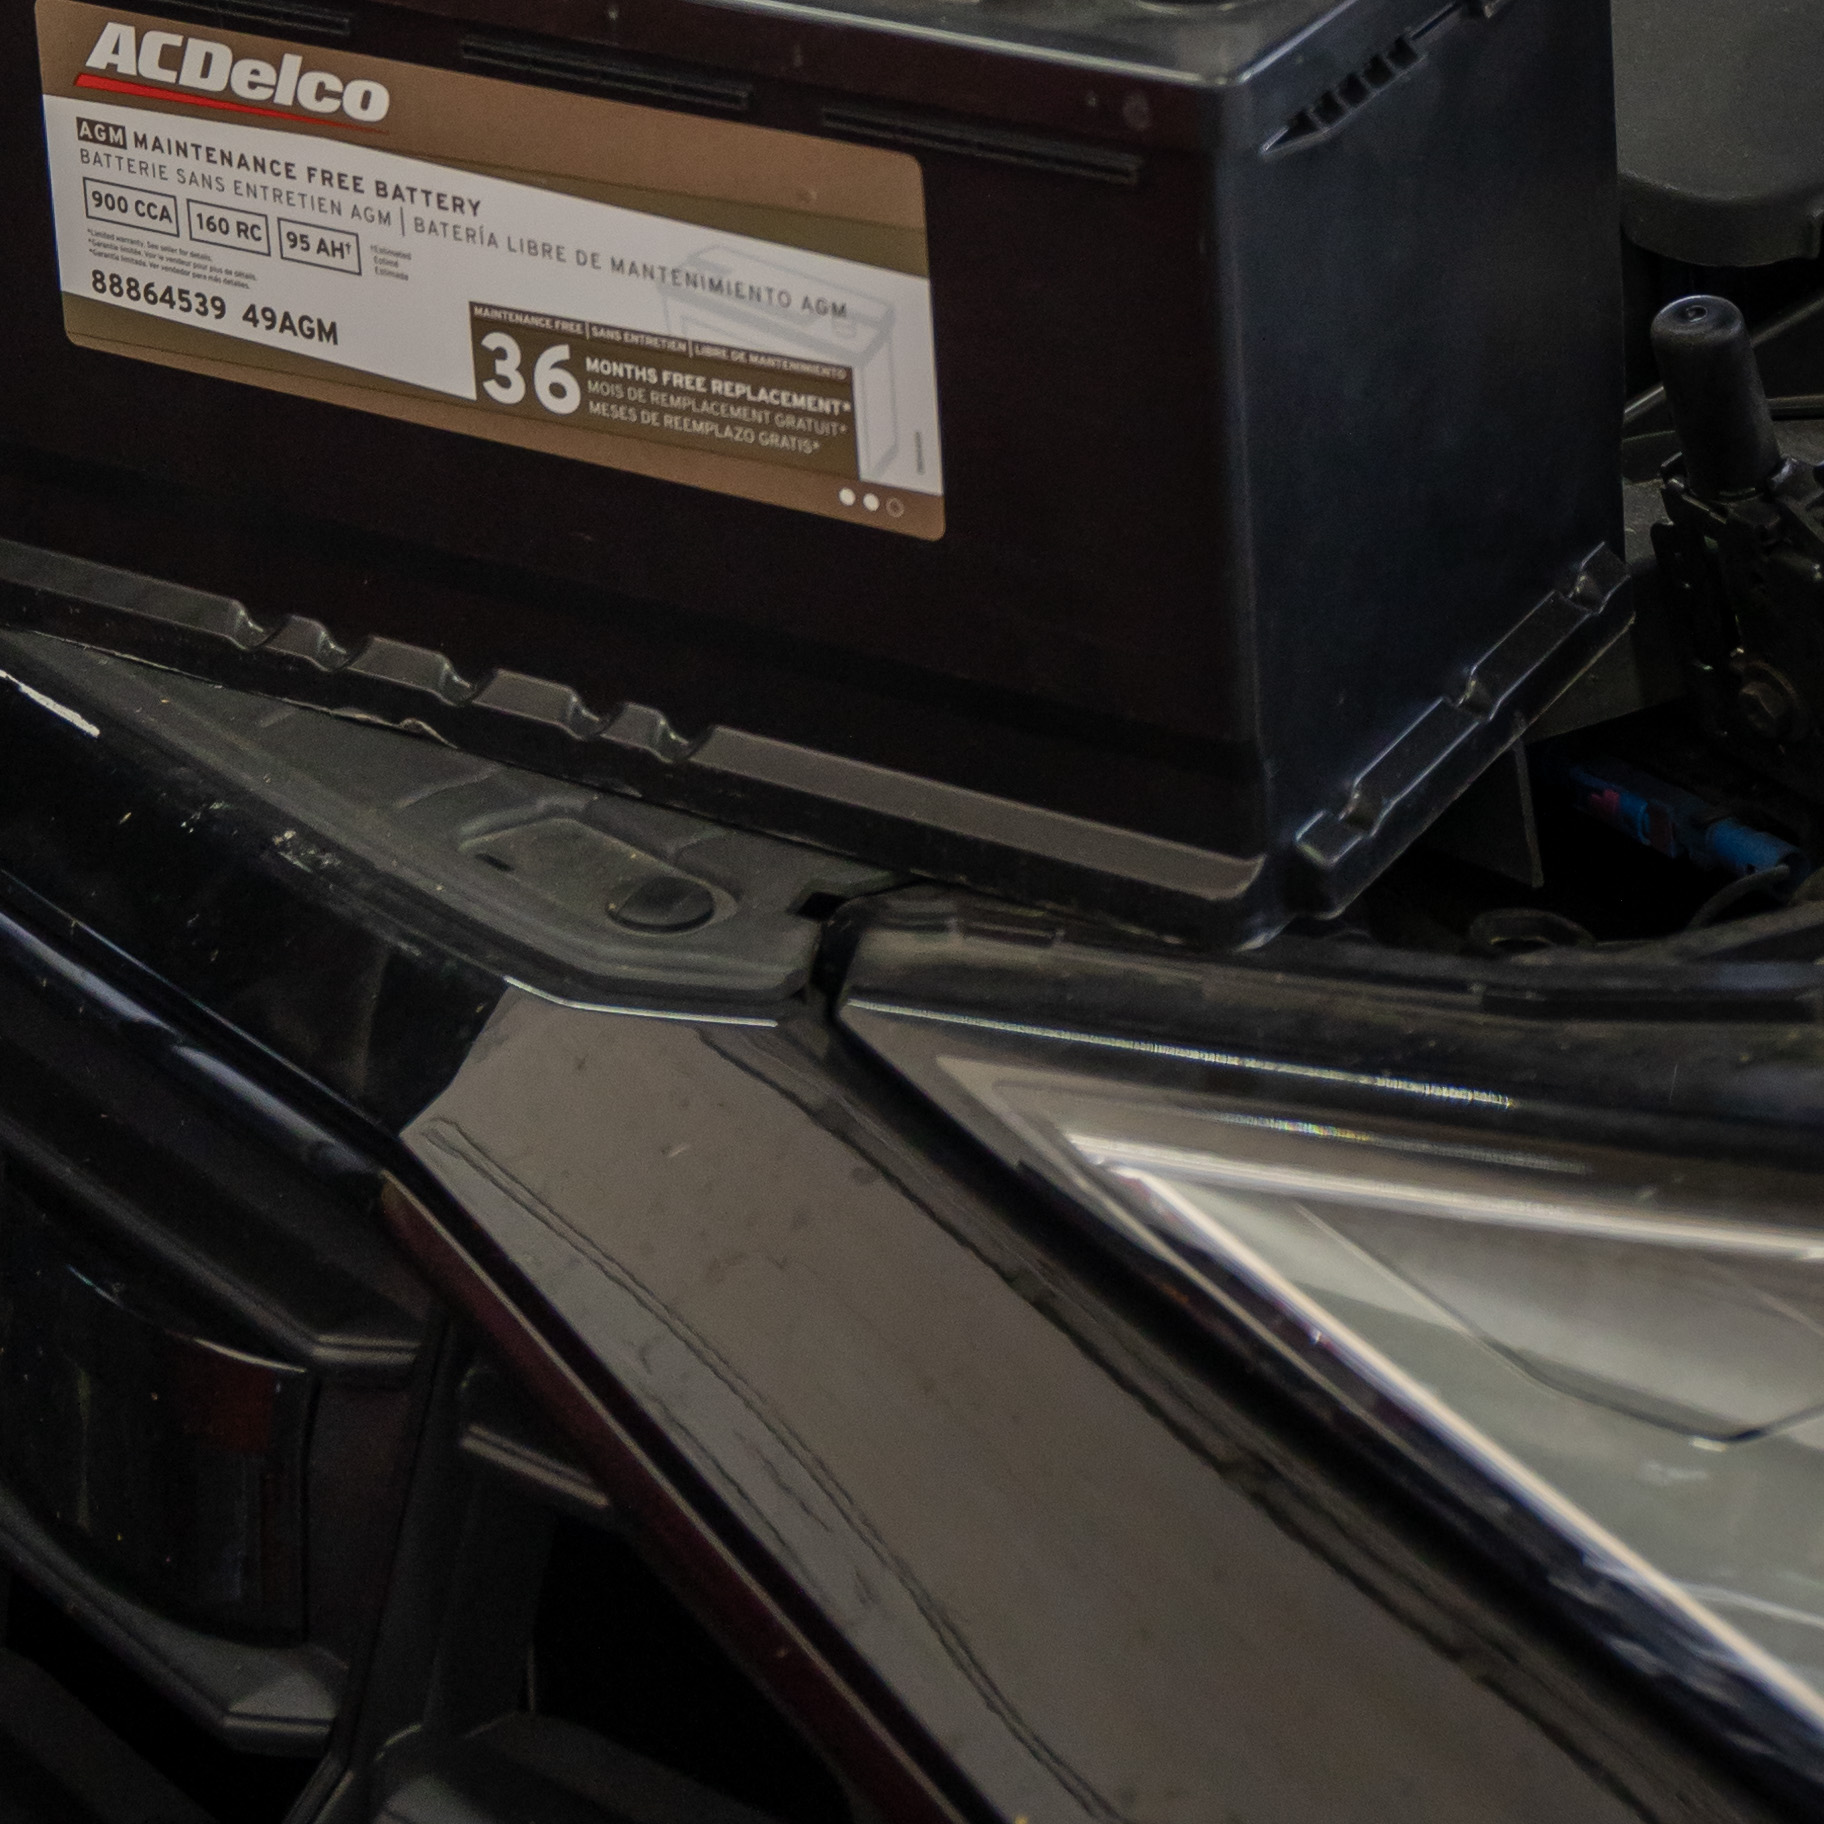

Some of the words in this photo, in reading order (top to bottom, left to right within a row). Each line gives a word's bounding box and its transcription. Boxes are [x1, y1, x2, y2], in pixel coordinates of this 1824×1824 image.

[85, 21, 391, 123] ACDelco
[79, 120, 124, 146] AGM
[133, 131, 297, 180] MAINTENANCE
[307, 166, 365, 194] FREE
[375, 180, 481, 218] BATTERY
[80, 148, 169, 181] BATTERIE
[177, 168, 226, 193] SANS
[233, 180, 342, 217] ENTRETIEN
[350, 204, 392, 227] AGM
[91, 190, 129, 214] 900
[134, 199, 173, 224] CCA
[195, 212, 230, 236] 160
[236, 219, 263, 242] RC
[286, 231, 312, 252] 95
[413, 216, 499, 249] BATERÍA
[507, 236, 567, 263] LIBRE
[576, 249, 602, 270] DE
[611, 258, 792, 309] MANTENIMIENTO
[801, 295, 848, 319] AGM
[91, 268, 227, 320] 88864539
[242, 303, 339, 346] 49AGM
[473, 306, 554, 330] MAINTENANCE
[554, 319, 584, 335] FREE
[591, 325, 622, 342] SANS
[624, 331, 687, 353] ENTRETIEN
[731, 349, 748, 363] DE
[480, 331, 582, 416] 36
[585, 355, 658, 385] MONTHS
[661, 369, 707, 393] FREE
[586, 380, 625, 400] MOIS
[627, 386, 647, 403] DE
[650, 390, 773, 428] REMPLACEMENT
[588, 400, 638, 423] MESES
[640, 409, 661, 426] DE
[663, 413, 756, 446] REEMPLAZO
